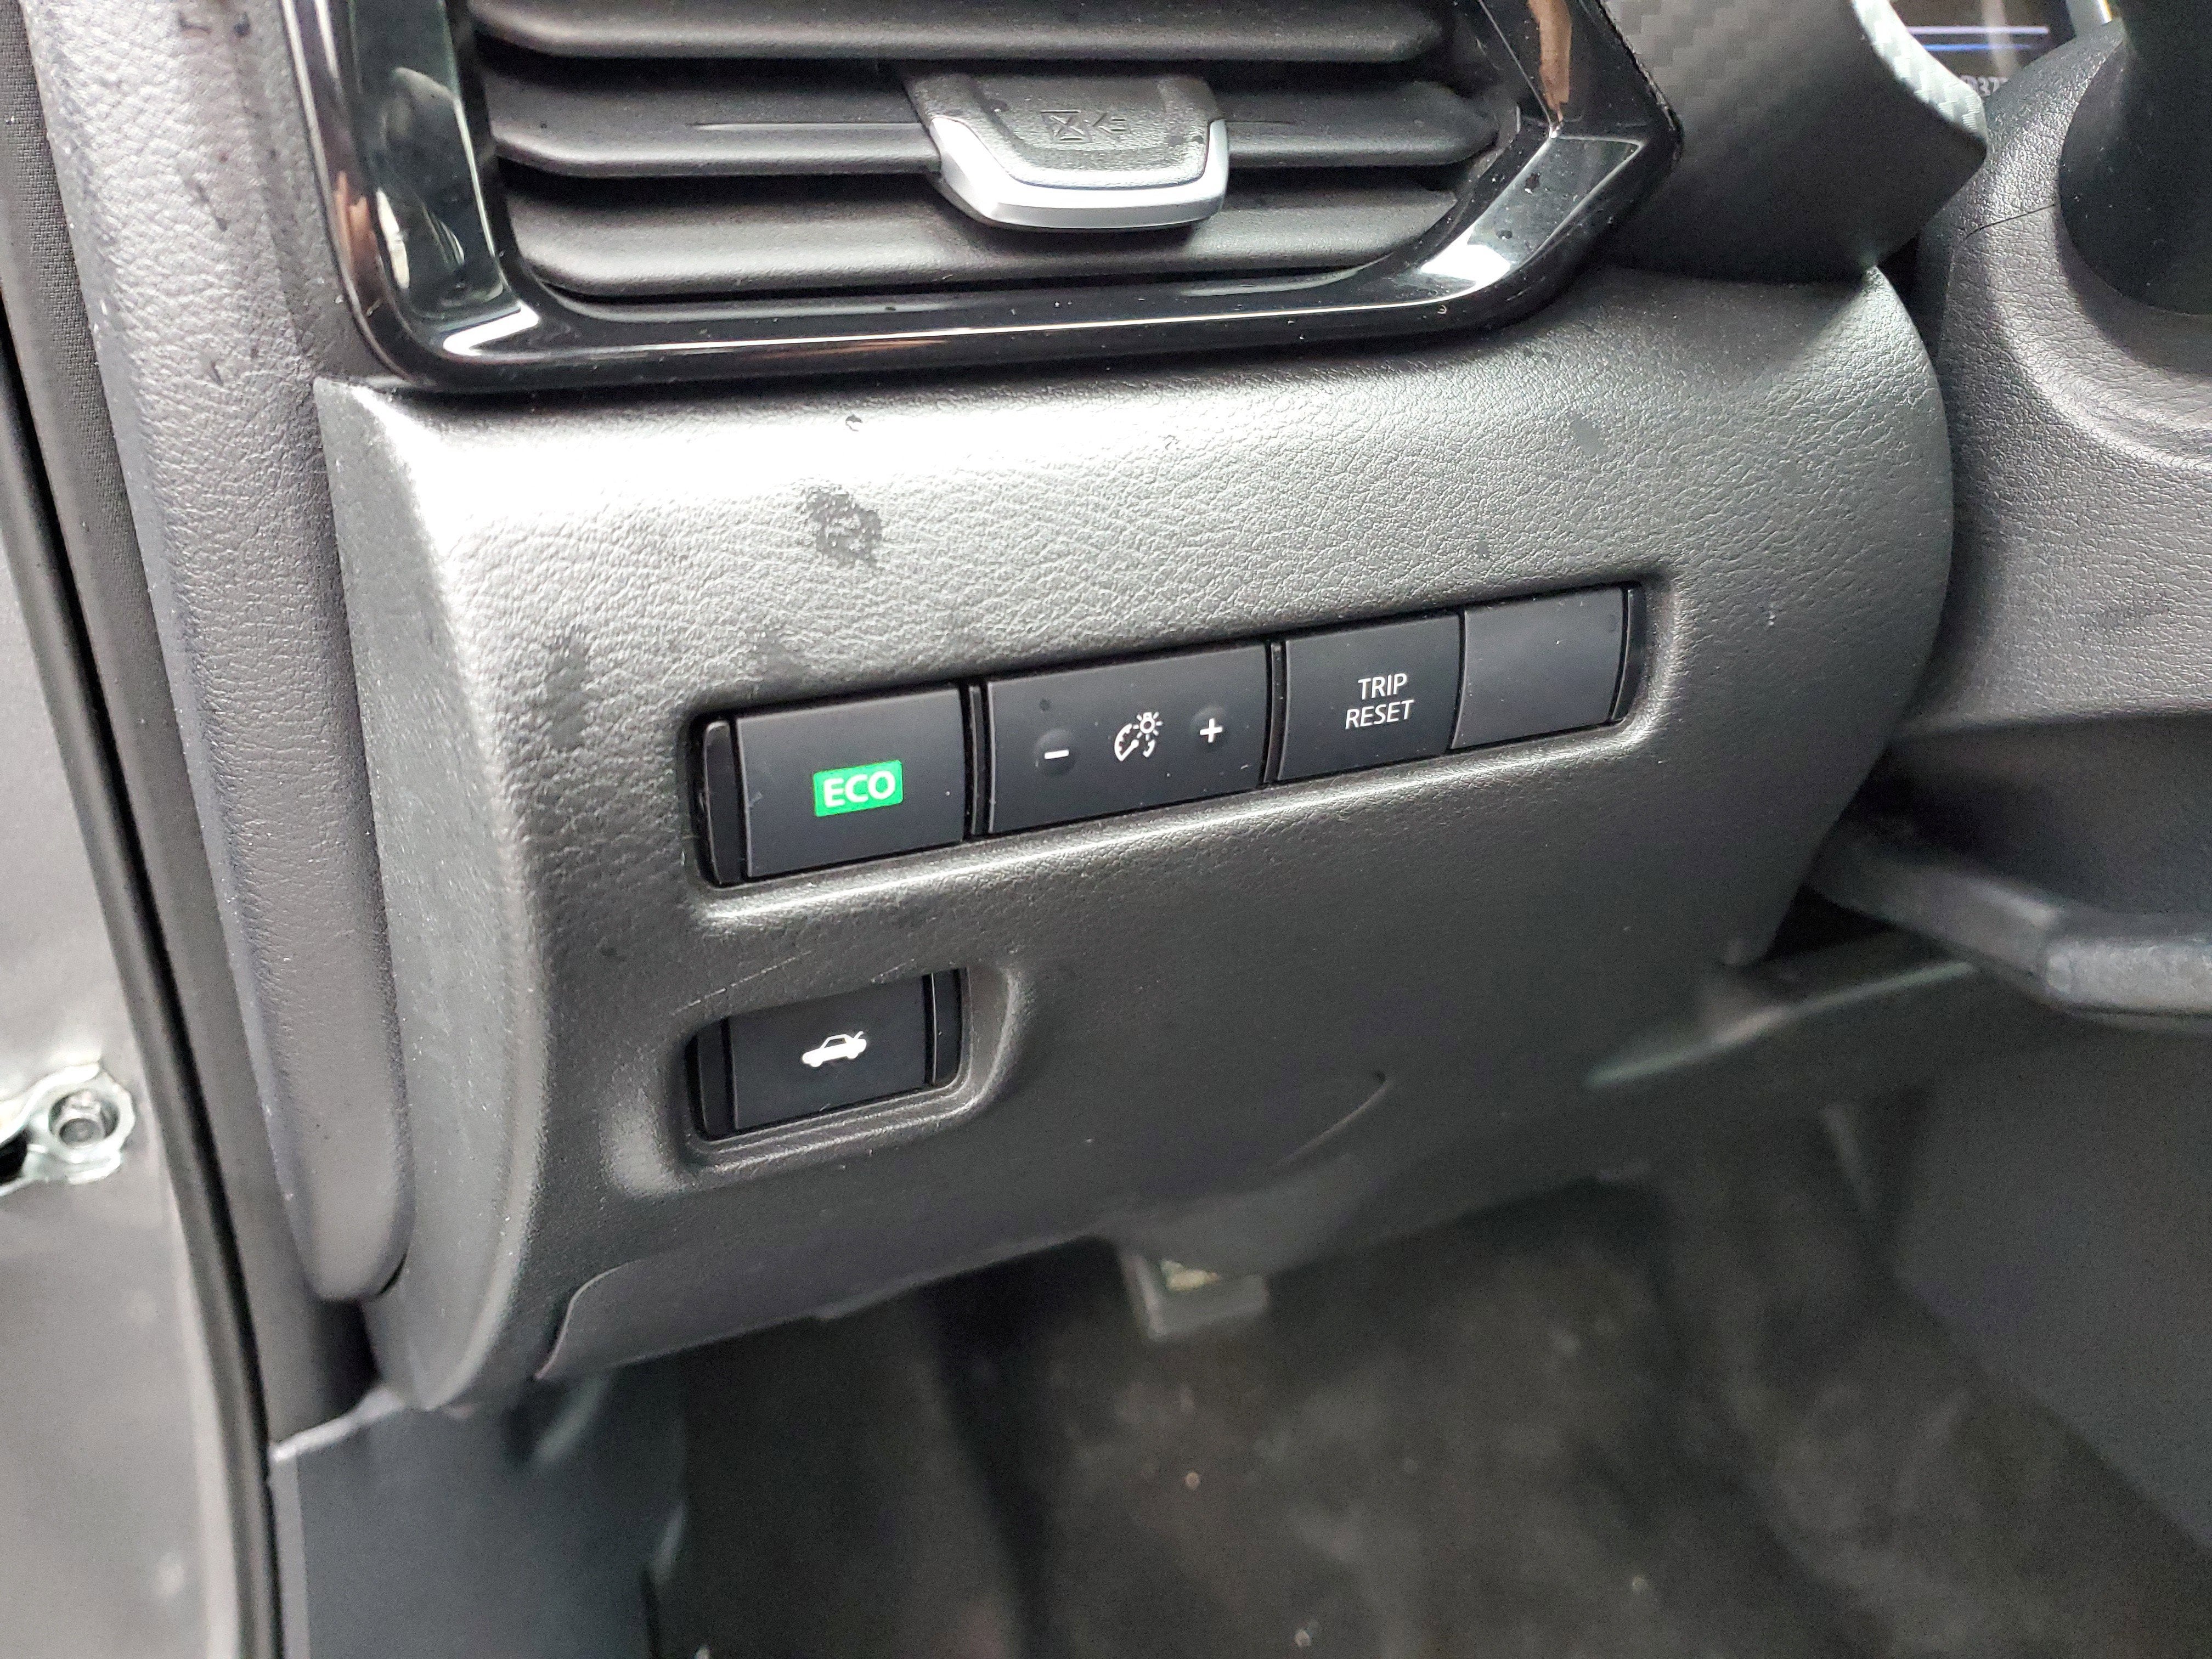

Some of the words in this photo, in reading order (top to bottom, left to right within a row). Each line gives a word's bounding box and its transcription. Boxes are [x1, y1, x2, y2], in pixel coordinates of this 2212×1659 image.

[1357, 673, 1408, 701] TRIP
[1345, 699, 1415, 730] RESET
[823, 770, 896, 808] ECO
